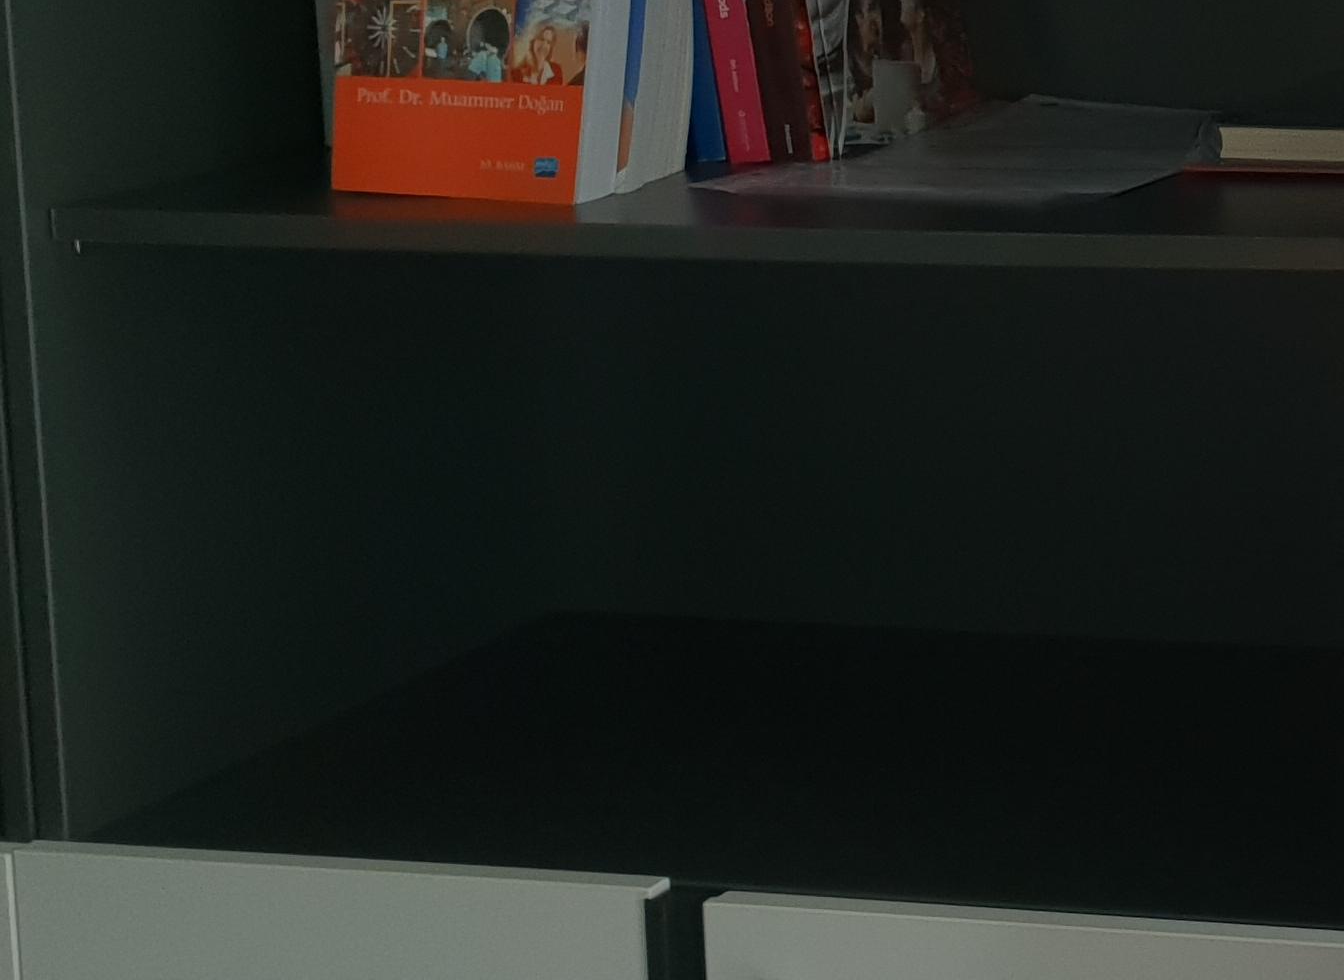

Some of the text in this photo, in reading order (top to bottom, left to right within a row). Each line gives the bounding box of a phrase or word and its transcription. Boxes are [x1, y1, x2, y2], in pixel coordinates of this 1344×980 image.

[399, 89, 423, 106] Dr.
[430, 90, 515, 110] Muammer
[518, 94, 566, 115] Doğan
